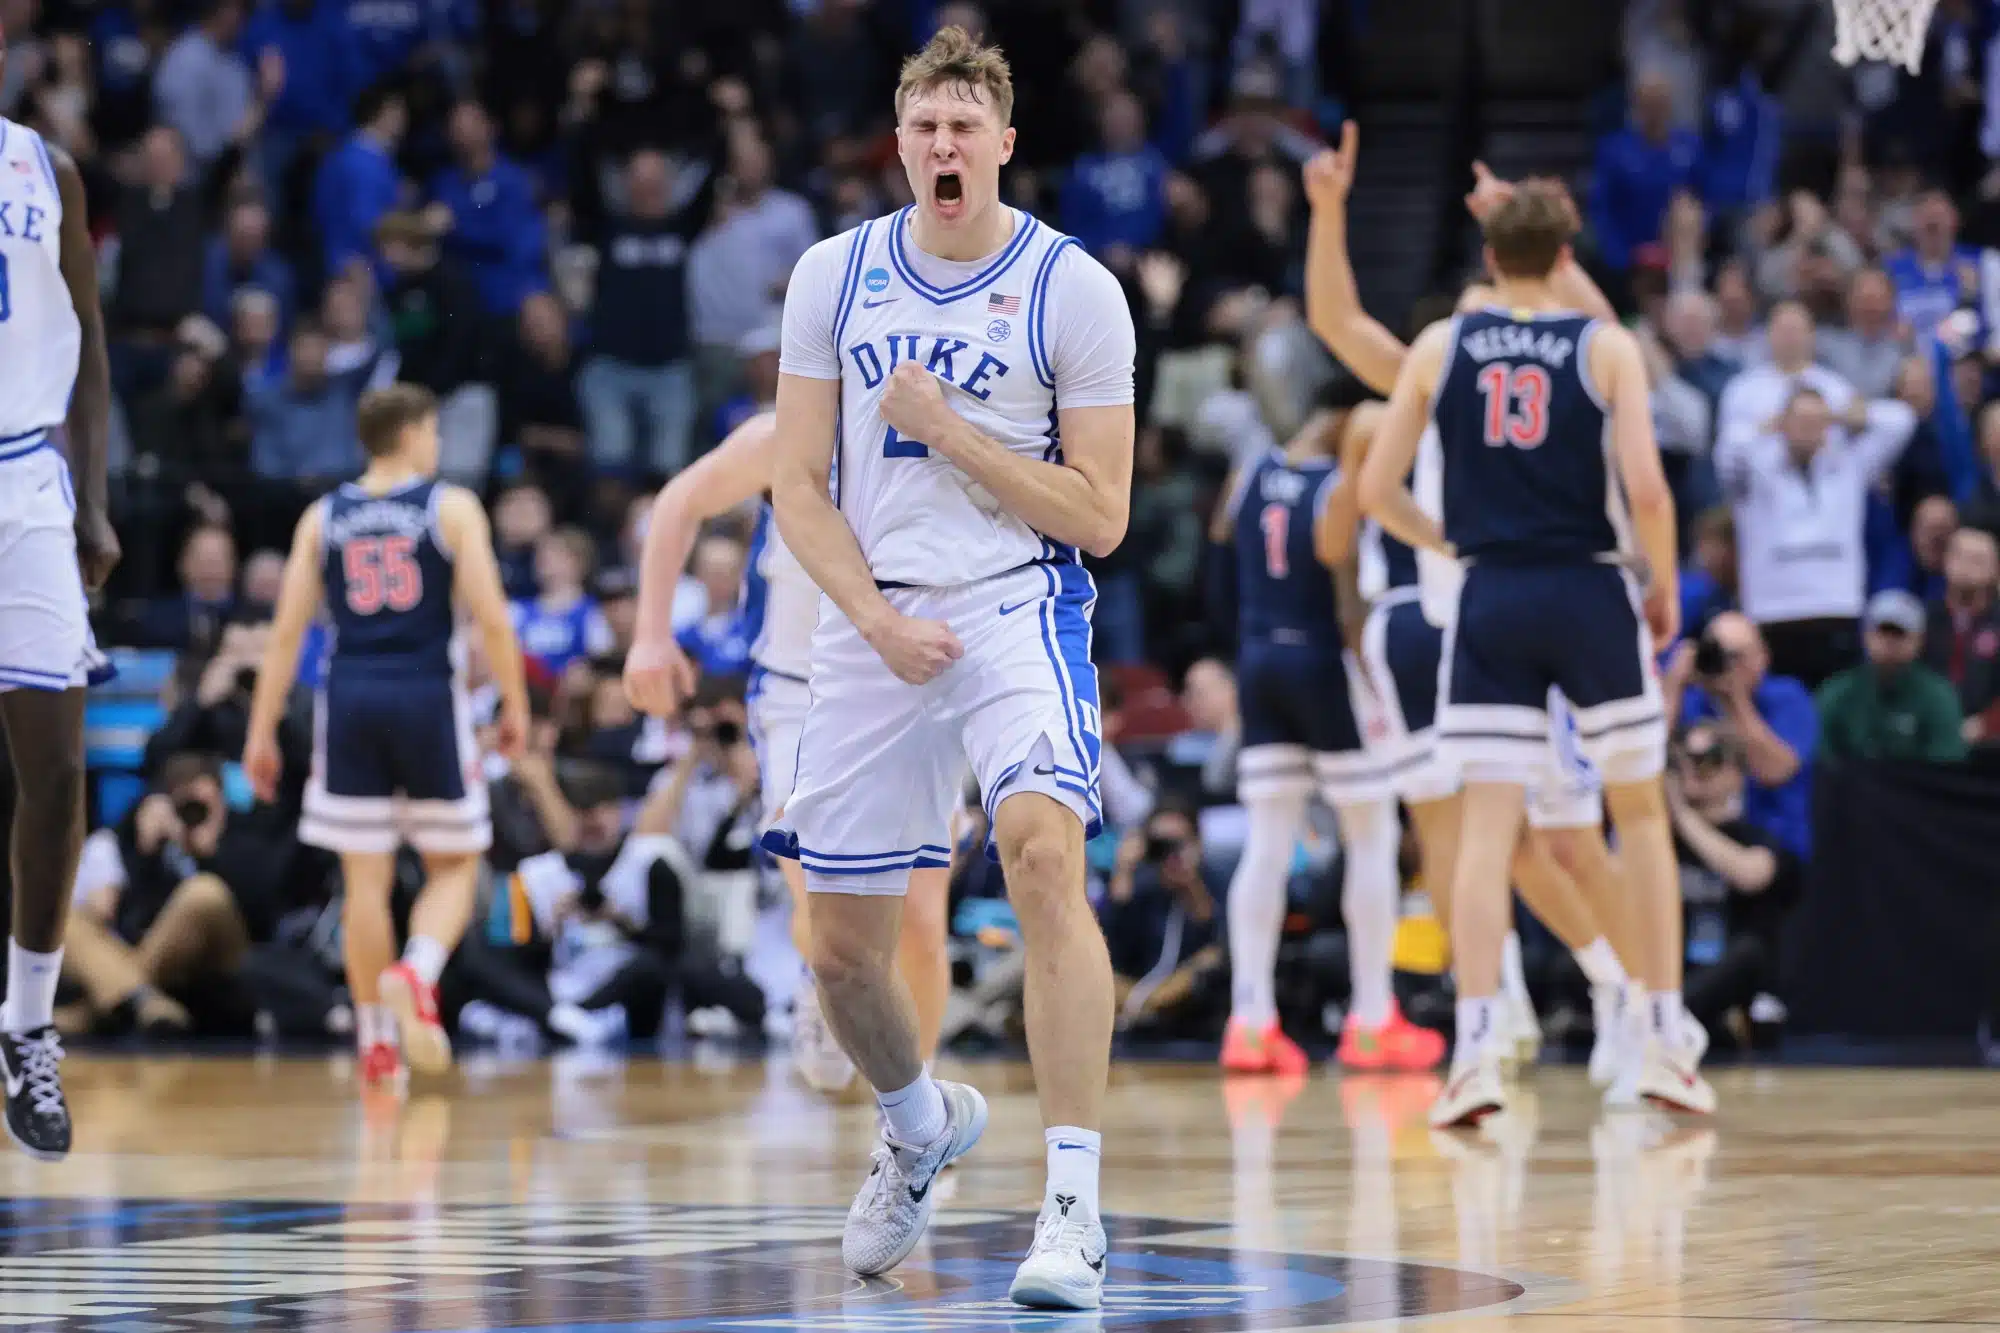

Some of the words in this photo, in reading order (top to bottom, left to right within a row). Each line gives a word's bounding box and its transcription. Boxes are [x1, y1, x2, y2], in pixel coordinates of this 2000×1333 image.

[867, 278, 888, 286] NCAA
[850, 335, 1009, 401] DUKE
[1476, 361, 1551, 450] 13
[342, 535, 424, 615] 55
[1259, 502, 1290, 579] 1
